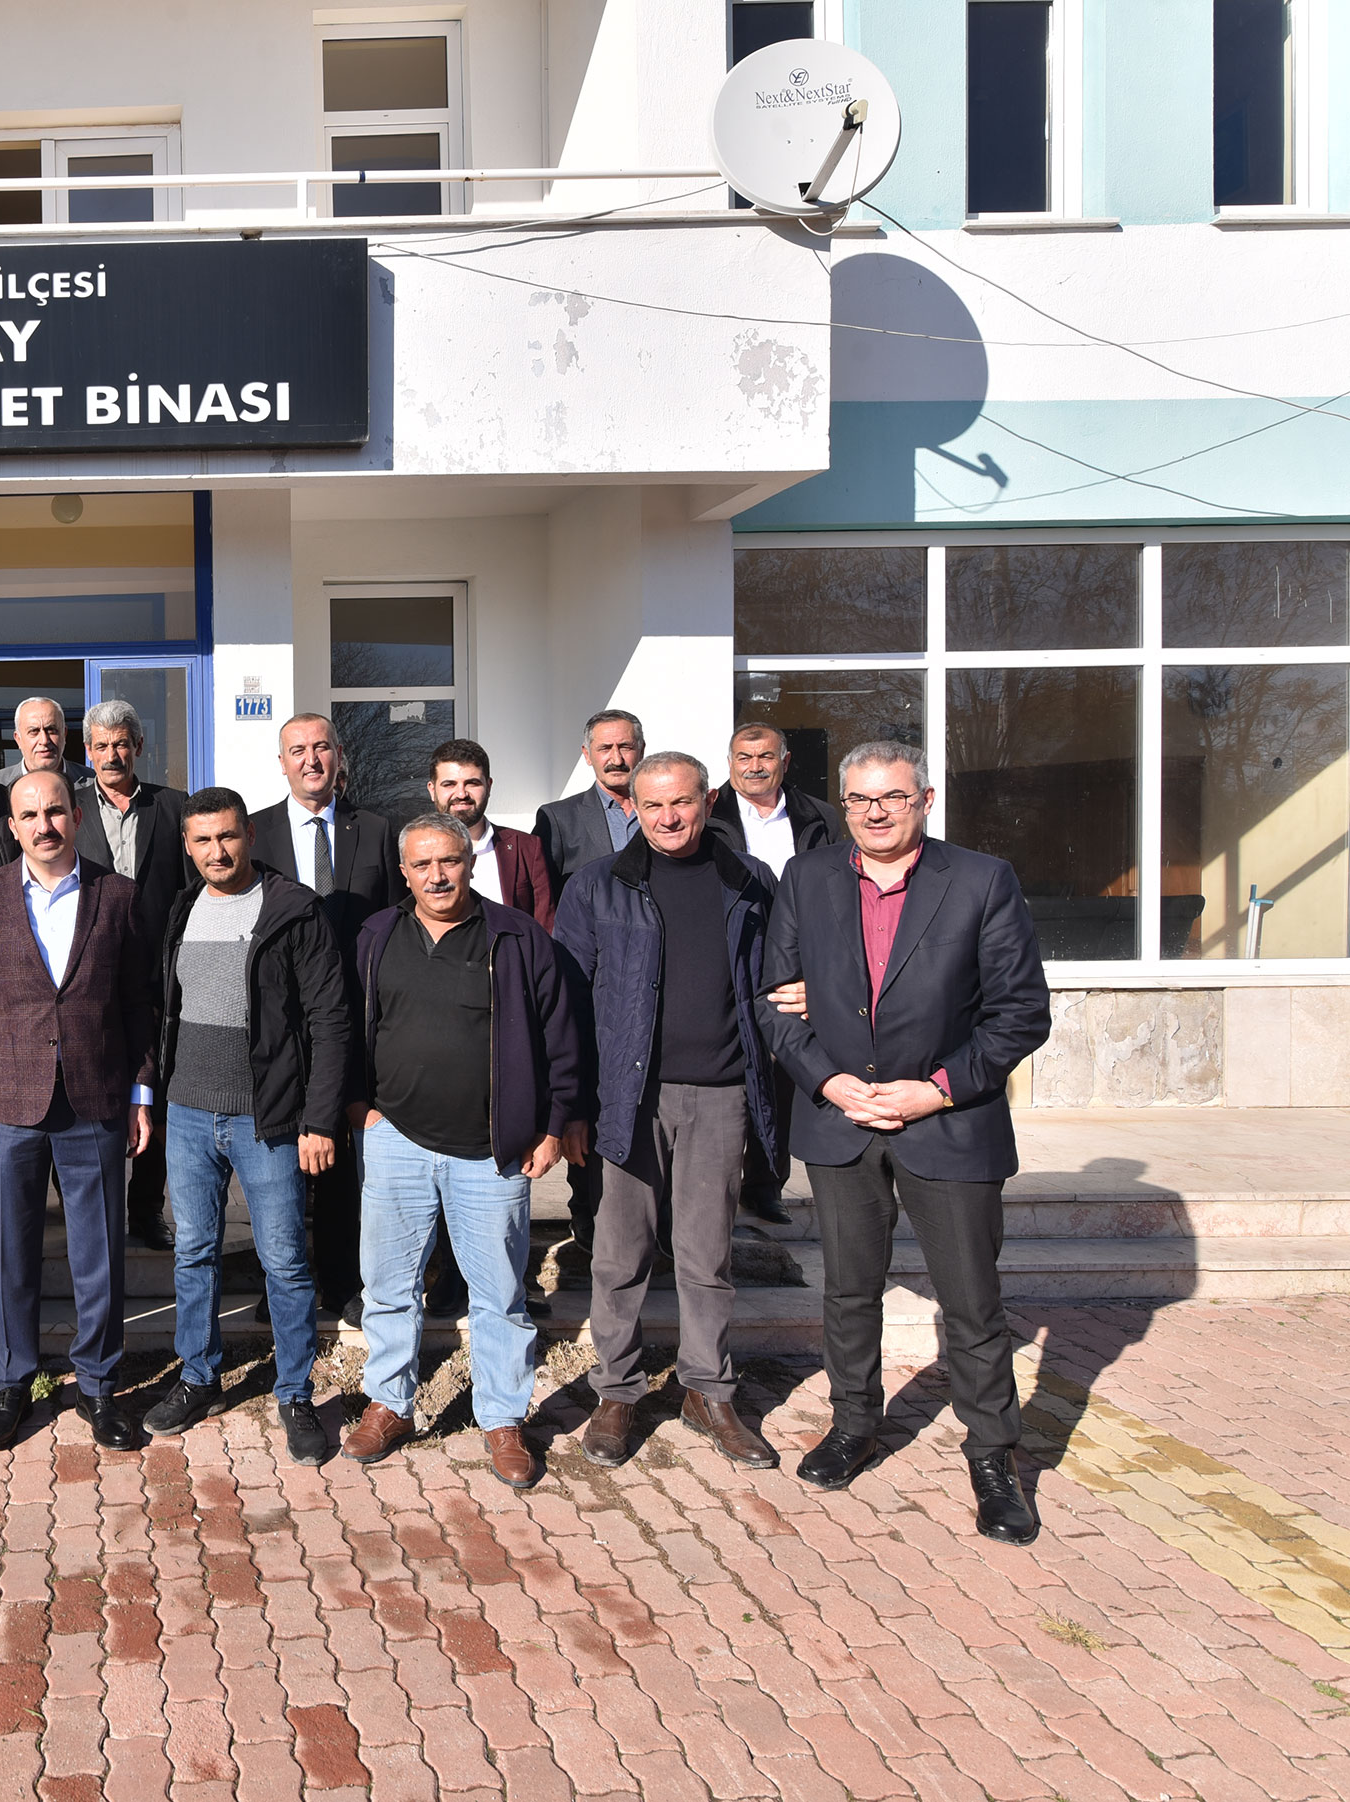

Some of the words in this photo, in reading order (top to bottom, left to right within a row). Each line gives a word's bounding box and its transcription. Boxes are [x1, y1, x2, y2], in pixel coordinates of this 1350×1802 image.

[806, 94, 850, 104] SYSTEMS
[86, 372, 290, 425] BİNASI
[238, 698, 268, 715] 1773
